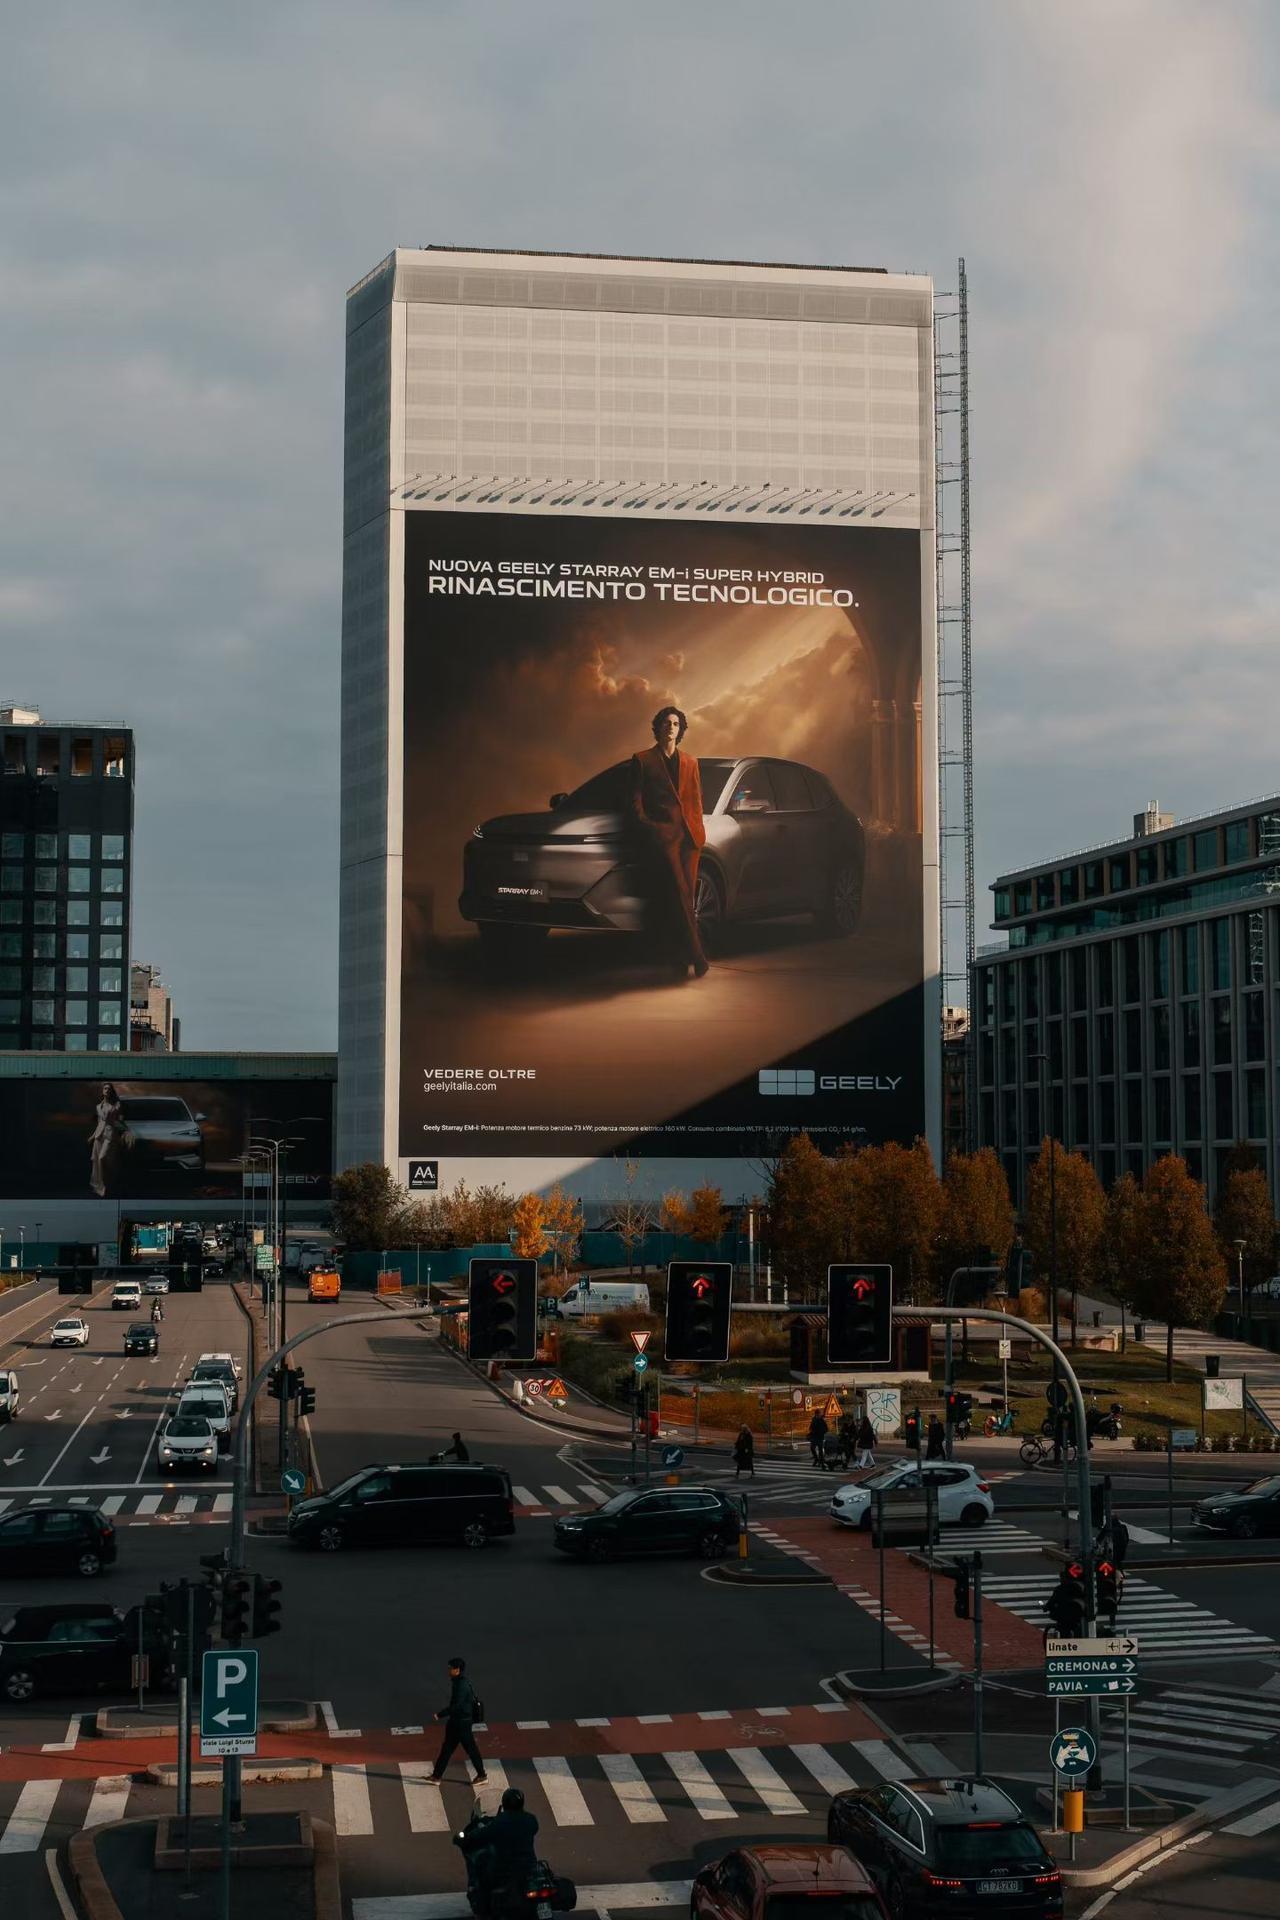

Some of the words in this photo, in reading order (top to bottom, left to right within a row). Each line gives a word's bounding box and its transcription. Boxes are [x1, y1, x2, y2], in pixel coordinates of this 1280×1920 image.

[429, 559, 493, 573] NUOVA
[498, 562, 555, 575] GEELY
[560, 564, 643, 578] STARRAY
[648, 566, 689, 580] EM-i
[693, 568, 753, 582] SUPER
[757, 570, 825, 584] HYBRID
[428, 576, 646, 600] RINASCIMENTO
[653, 583, 860, 608] TECNOLOGICO.
[423, 1069, 484, 1079] VEDERE
[488, 1069, 537, 1079] OLTRE
[423, 1081, 497, 1092] geelyitalia.com
[819, 1076, 902, 1090] GEELY
[423, 1124, 440, 1132] Geely
[441, 1124, 464, 1132] Starray
[530, 1384, 540, 1392] 30
[1048, 1661, 1109, 1672] CREMONA
[217, 1658, 247, 1698] P
[1048, 1681, 1083, 1692] PAVIA
